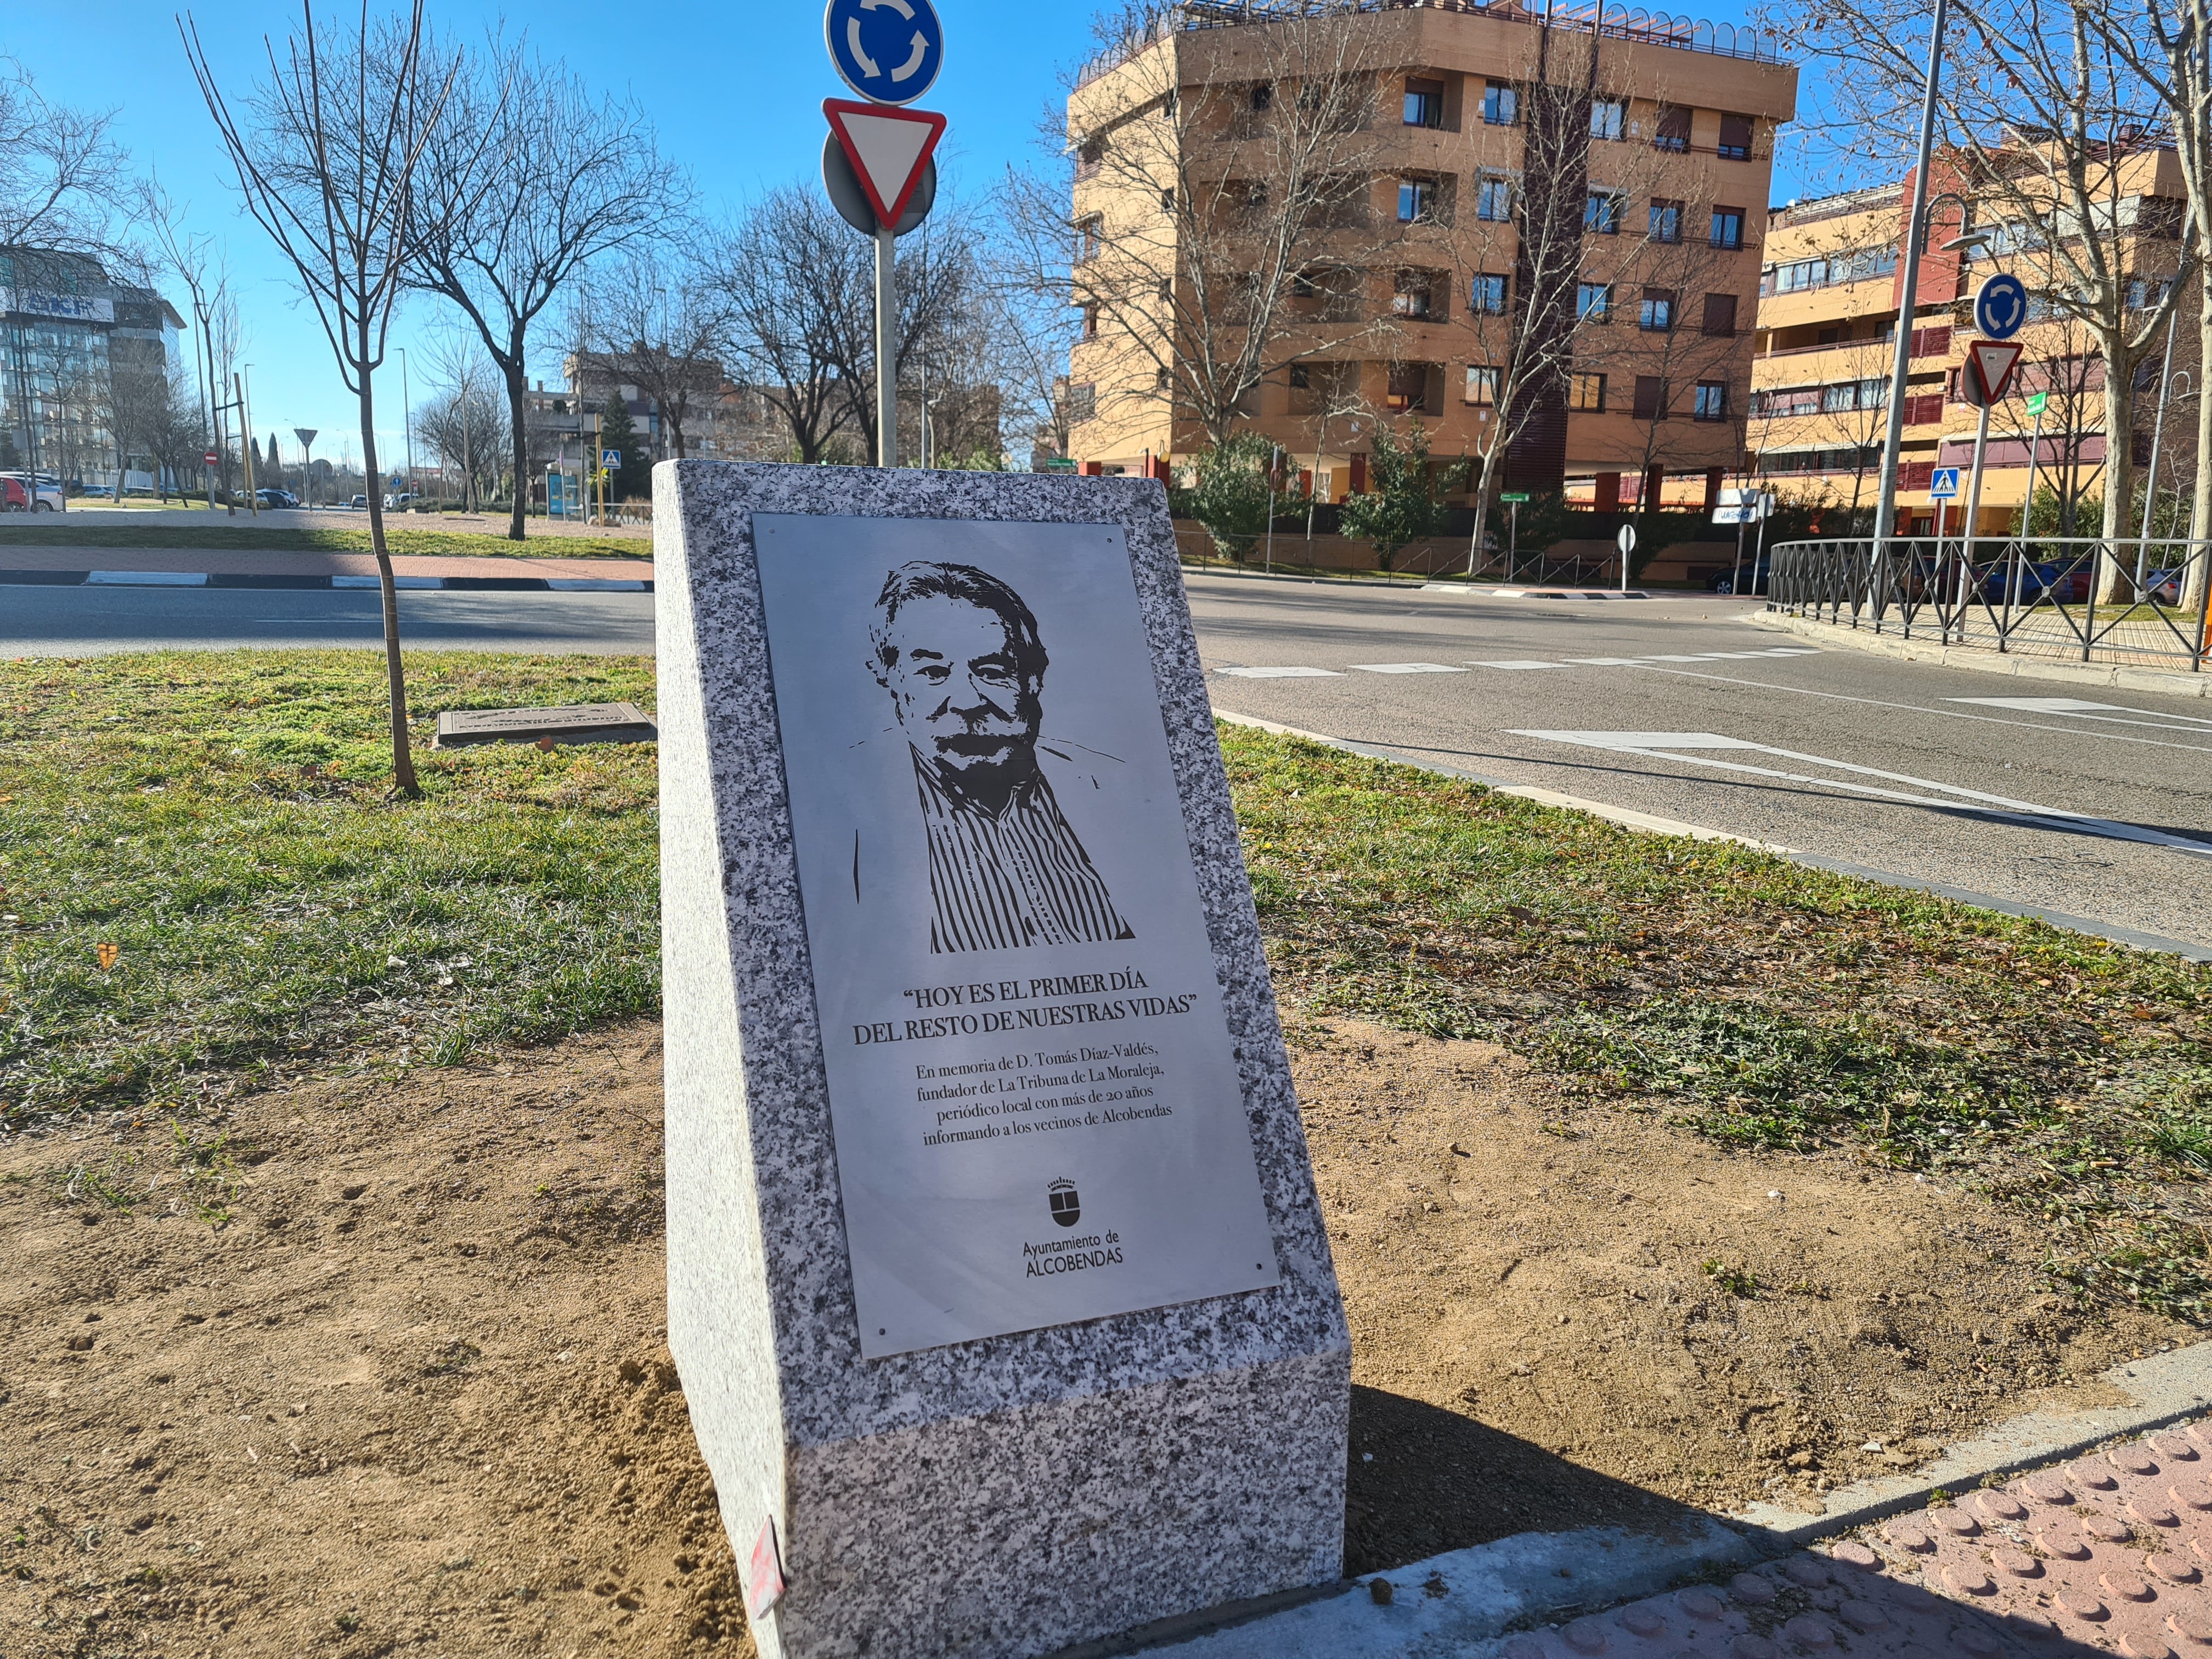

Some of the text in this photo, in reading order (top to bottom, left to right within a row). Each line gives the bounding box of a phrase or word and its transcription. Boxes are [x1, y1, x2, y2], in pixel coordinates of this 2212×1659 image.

[904, 966, 1148, 1009] “HOY ES EL PRIMER DÍA
[853, 994, 1197, 1045] DEL RESTO DE NUESTRAS VIDAS”
[916, 1042, 1158, 1079] En memoria de D. Tomás Díaz-Valdés,
[917, 1063, 1165, 1102] fundador de La Tribuna de La Moraleja,
[923, 1104, 1172, 1146] informando a los vecinos de Alcobendas
[936, 1086, 1154, 1126] periódico local con más de 20 años
[1023, 1229, 1119, 1260] Ayuntamiento de
[1026, 1247, 1123, 1278] ALCOBENDAS
